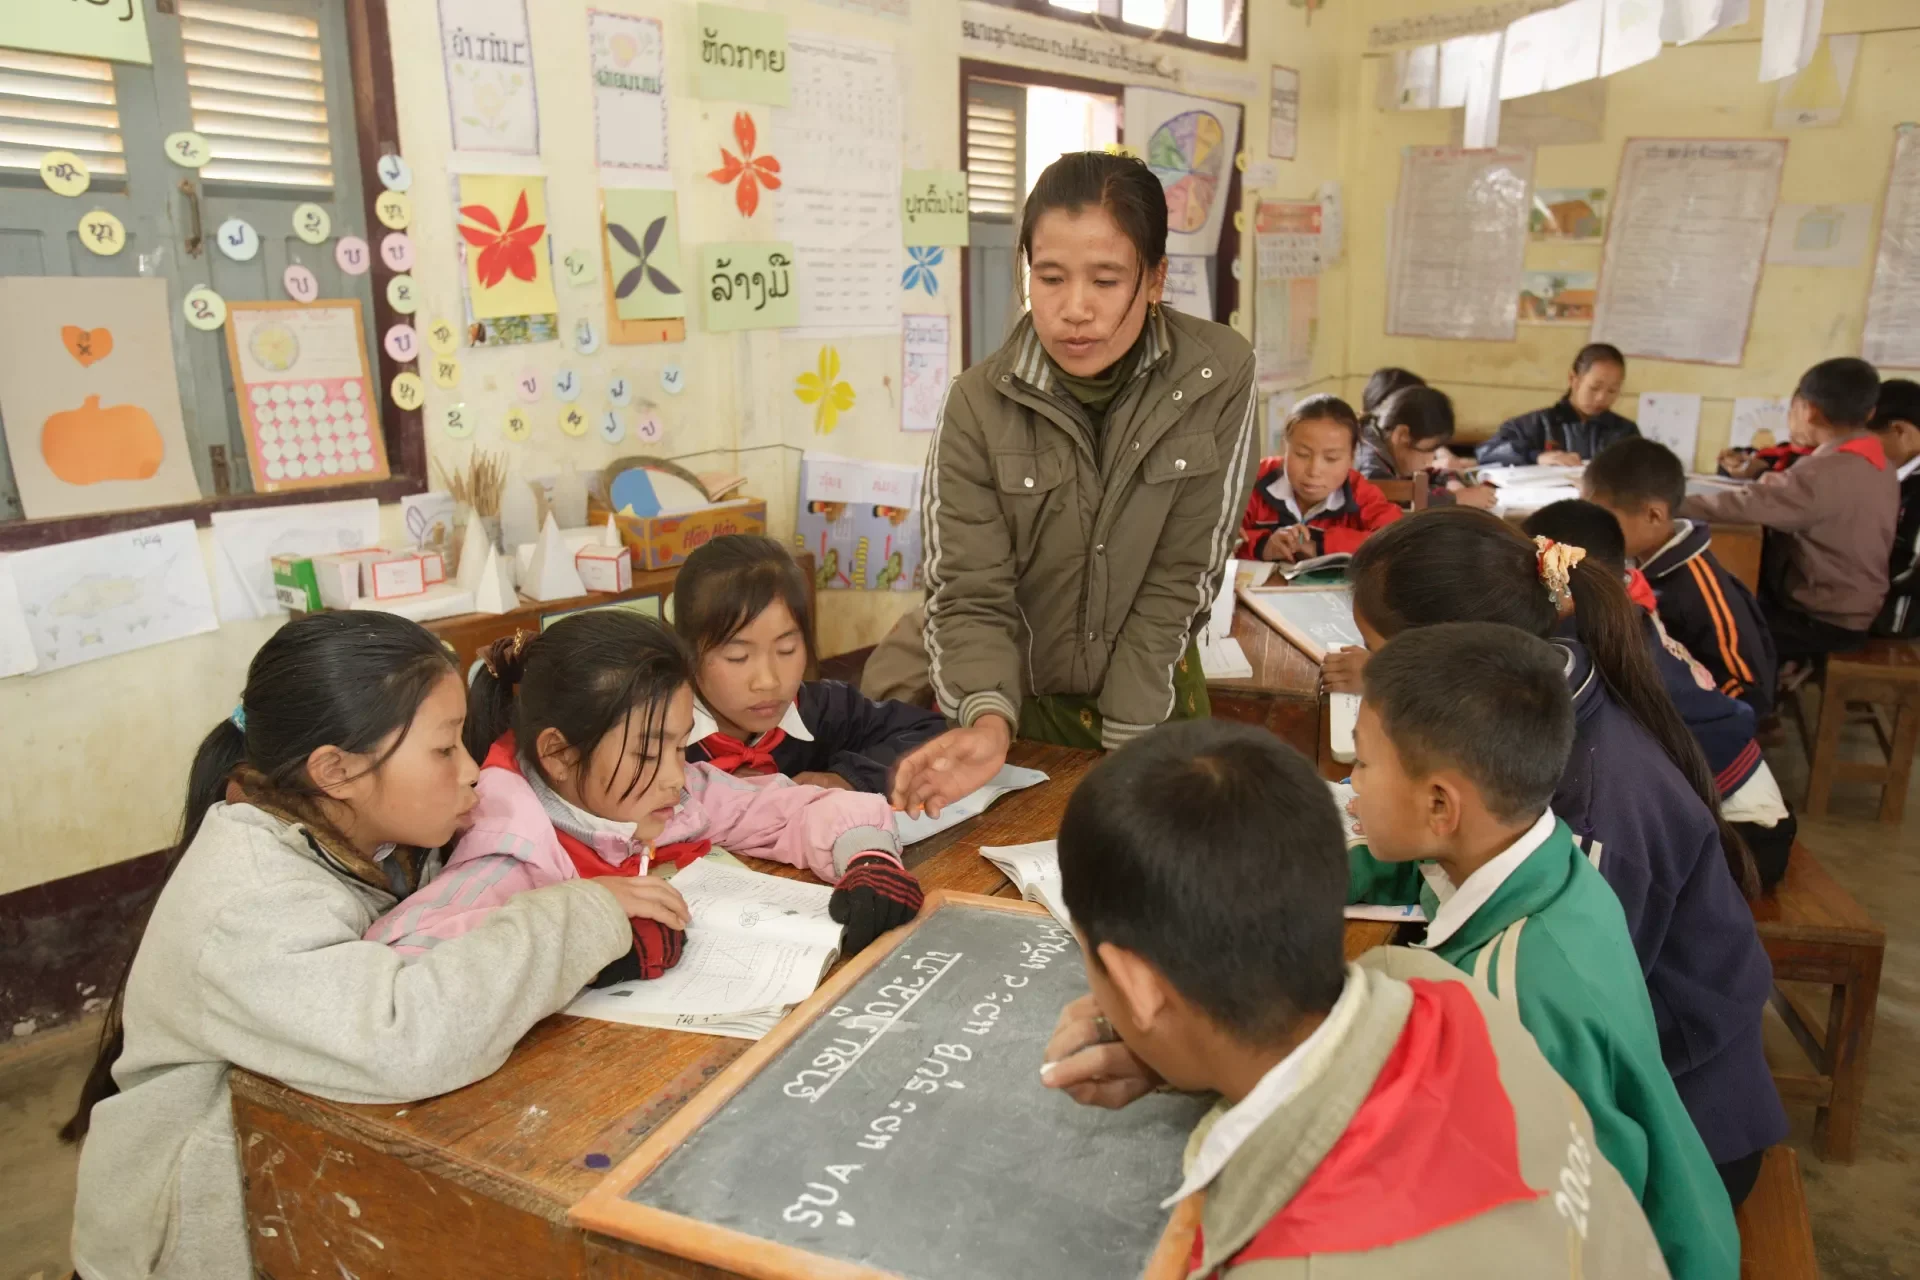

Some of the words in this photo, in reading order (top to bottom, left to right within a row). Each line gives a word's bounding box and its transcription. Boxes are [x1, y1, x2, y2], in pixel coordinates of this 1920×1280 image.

[702, 26, 785, 73] ຫັດກາຍ
[711, 253, 791, 311] ລ້າງມື
[826, 1162, 866, 1186] A
[932, 1041, 974, 1064] B
